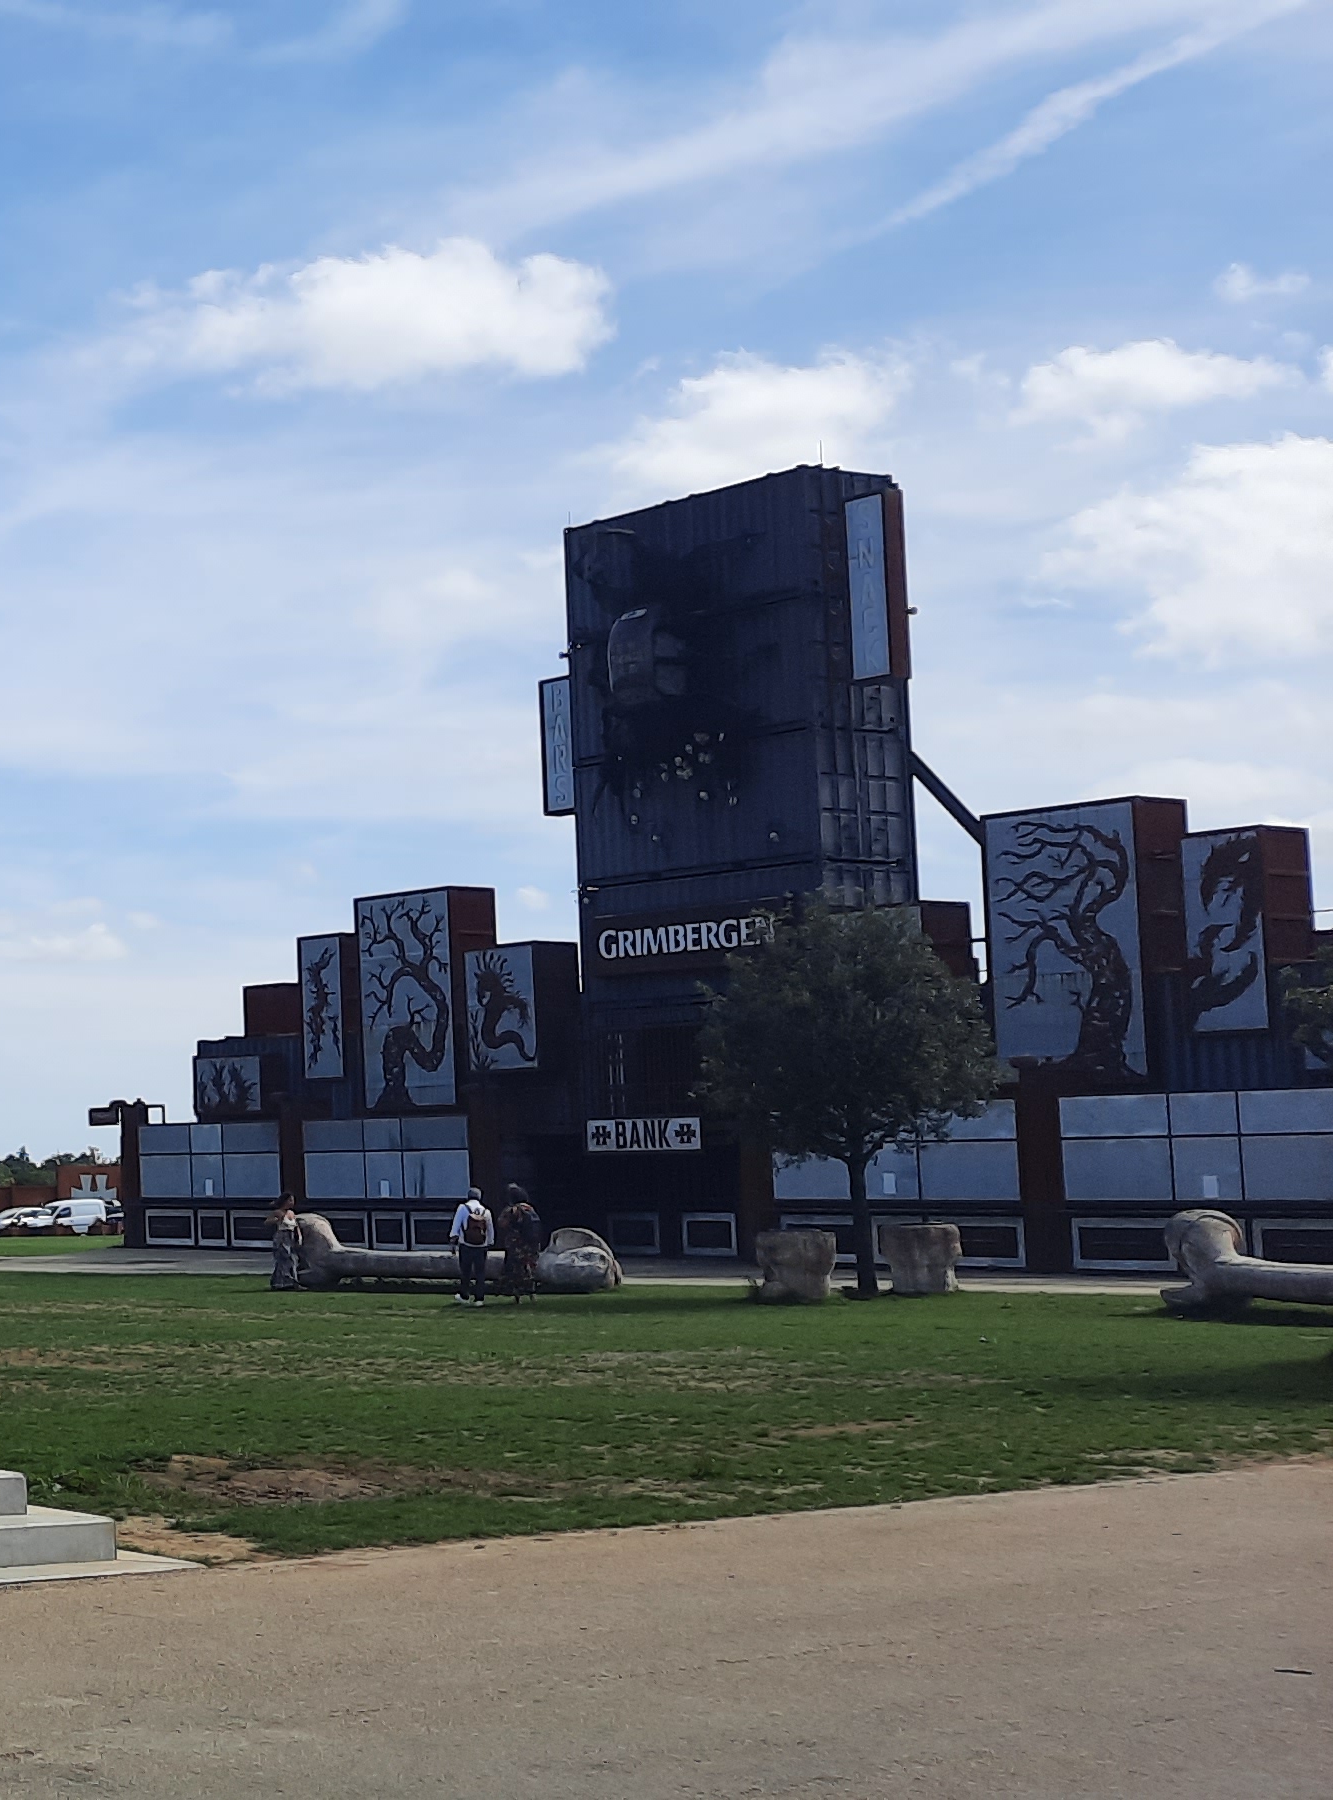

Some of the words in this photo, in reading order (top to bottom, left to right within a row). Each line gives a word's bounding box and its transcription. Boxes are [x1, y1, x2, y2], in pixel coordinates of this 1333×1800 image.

[854, 501, 883, 672] SNACK
[550, 684, 569, 804] BARS
[615, 1120, 672, 1149] BANK
